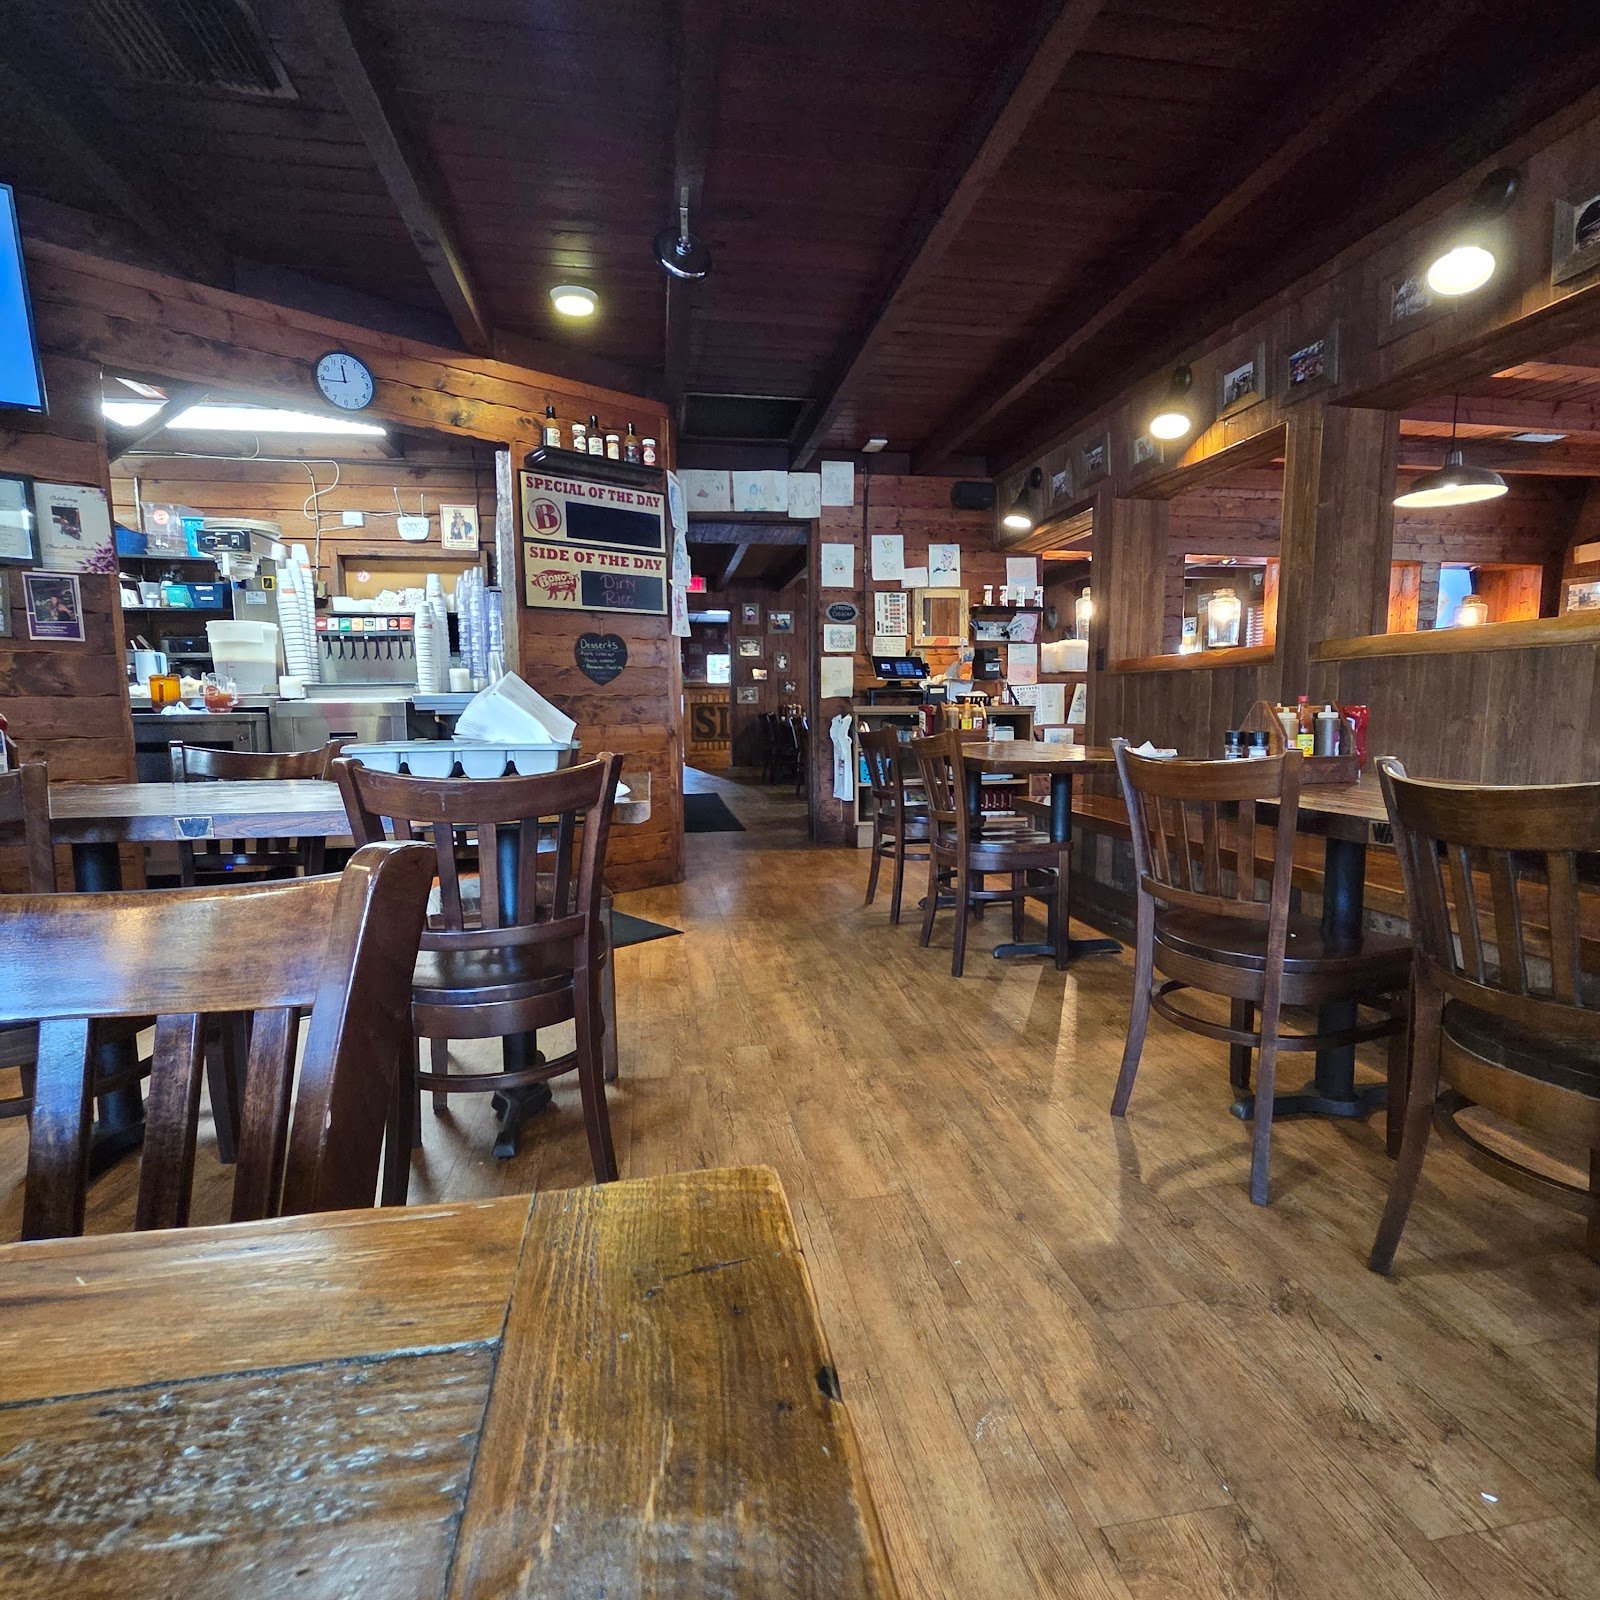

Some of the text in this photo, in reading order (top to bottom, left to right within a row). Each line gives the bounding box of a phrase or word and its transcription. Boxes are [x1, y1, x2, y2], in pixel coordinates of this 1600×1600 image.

[340, 357, 347, 365] 12
[526, 476, 661, 508] SPECIAL OF THE DAY
[534, 503, 558, 530] B
[529, 546, 662, 571] SIDE OF THE DAY
[600, 574, 636, 593] Dirty
[601, 592, 634, 606] Rice
[580, 638, 619, 650] Desserts
